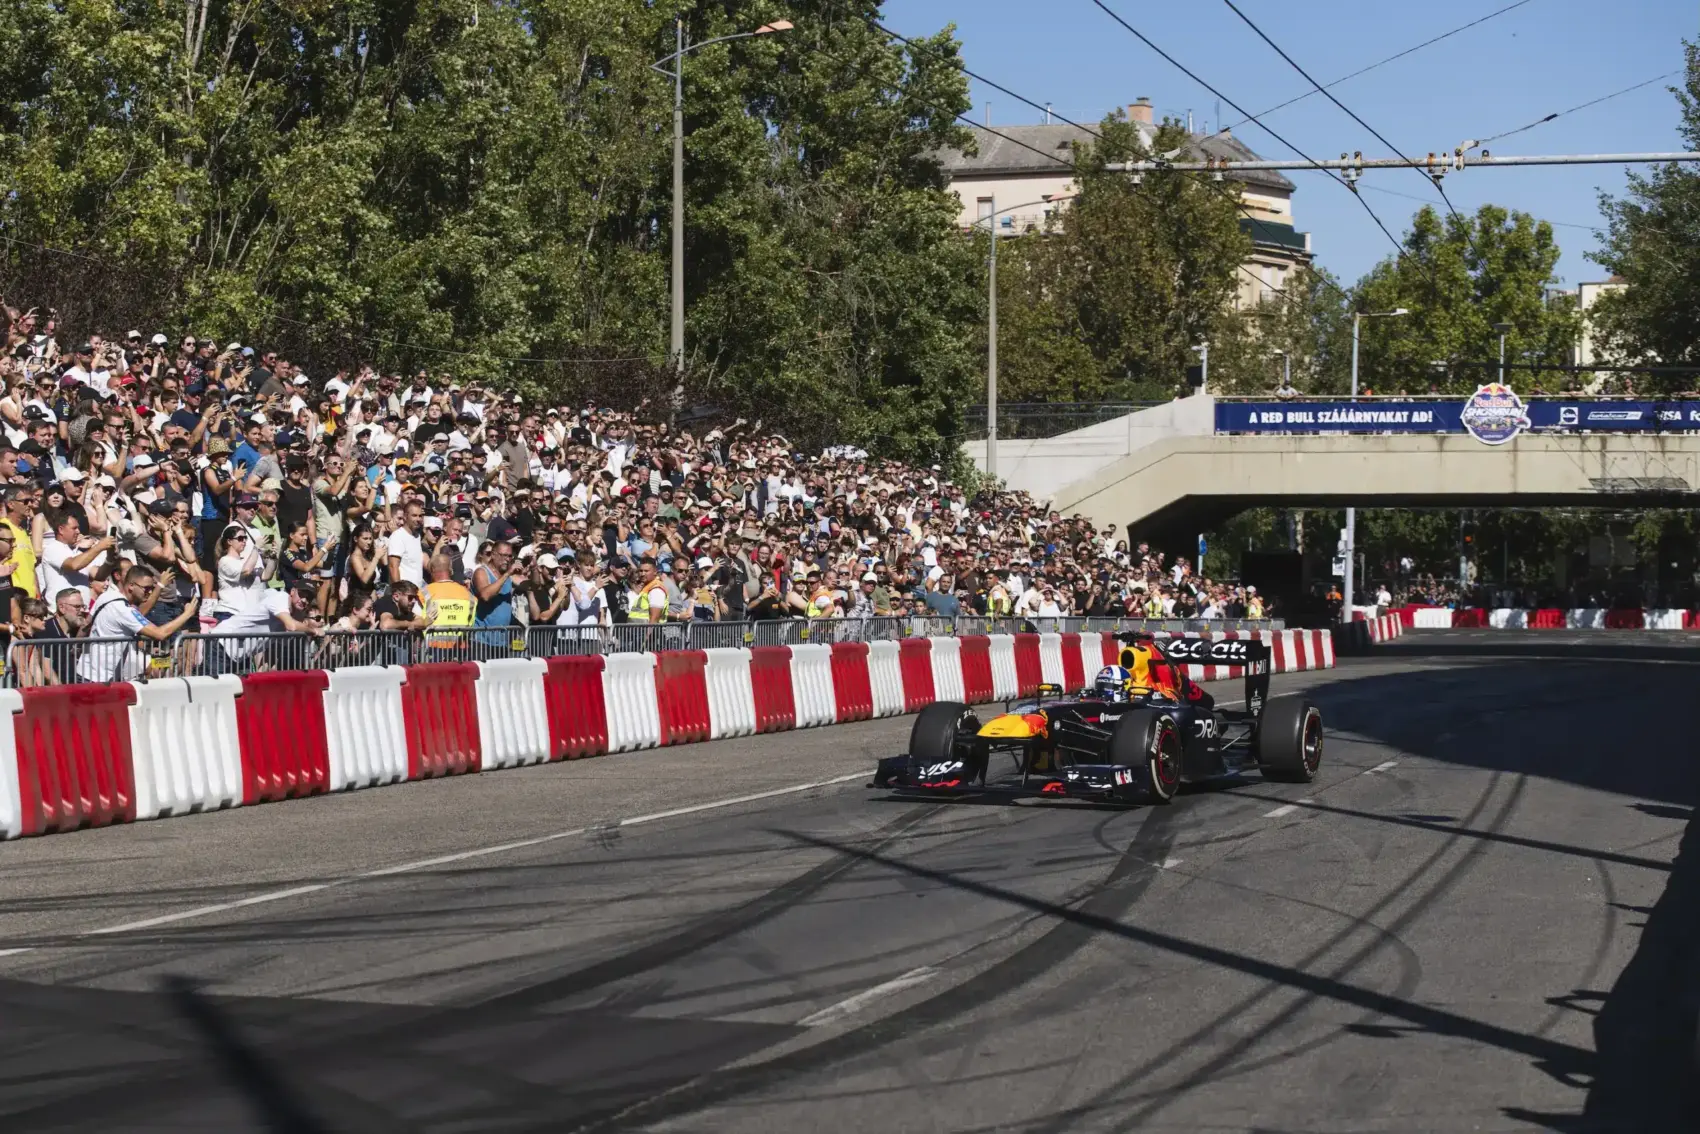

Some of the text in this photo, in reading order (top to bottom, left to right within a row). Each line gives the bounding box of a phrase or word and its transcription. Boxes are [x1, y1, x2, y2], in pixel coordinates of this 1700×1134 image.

[1249, 408, 1433, 423] A RED BULL SZÁÁÁRNYAKAT AD!
